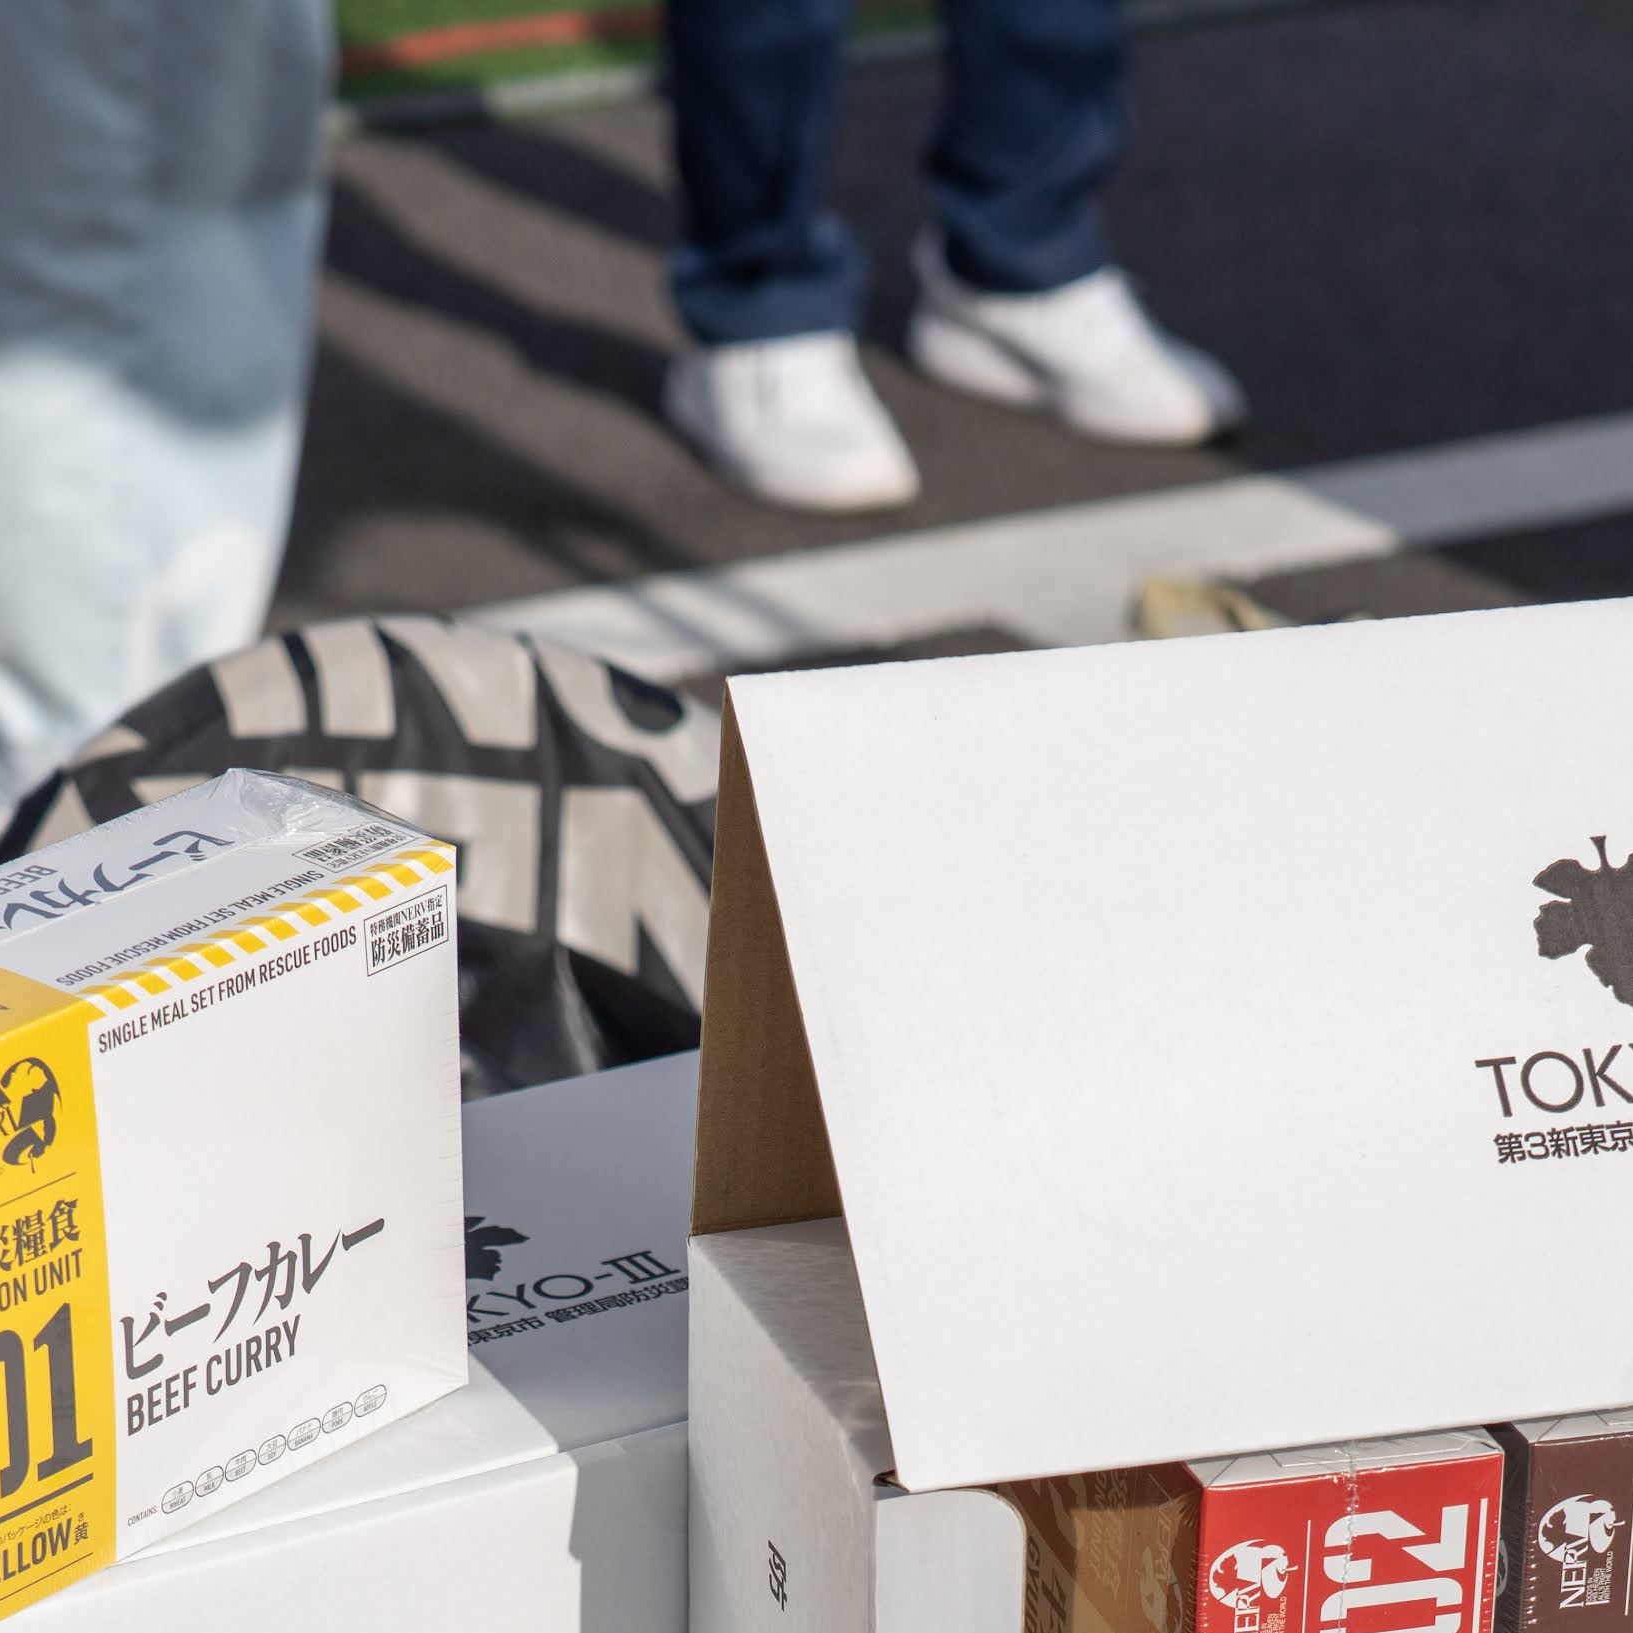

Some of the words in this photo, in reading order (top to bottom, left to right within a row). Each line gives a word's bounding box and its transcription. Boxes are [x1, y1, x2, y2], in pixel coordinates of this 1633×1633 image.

[267, 868, 324, 897] SINGLE
[203, 907, 233, 925] SET
[230, 891, 270, 913] MEAL
[369, 894, 443, 937] 特務機関NERV指定
[165, 918, 206, 941] FROM
[371, 911, 445, 968] 防災備蓄品
[106, 935, 167, 966] RESCUE
[56, 960, 109, 987] FOODS
[99, 1016, 148, 1054] SINGLE
[150, 999, 188, 1032] MEAL
[191, 986, 215, 1014] SET
[218, 969, 256, 1002] FROM
[260, 946, 311, 985] RESCUE
[313, 926, 357, 960] FOODS
[34, 1248, 83, 1297] UNIT
[467, 1250, 680, 1324] KYO-III
[120, 1218, 385, 1380] ビーフカレー
[468, 1316, 546, 1347] 東京市
[127, 1364, 198, 1437] BEEF
[206, 1314, 301, 1396] CURRY
[127, 1505, 159, 1527] CONTAINS:
[73, 1521, 89, 1546] 黄
[1560, 1537, 1588, 1609] NERV
